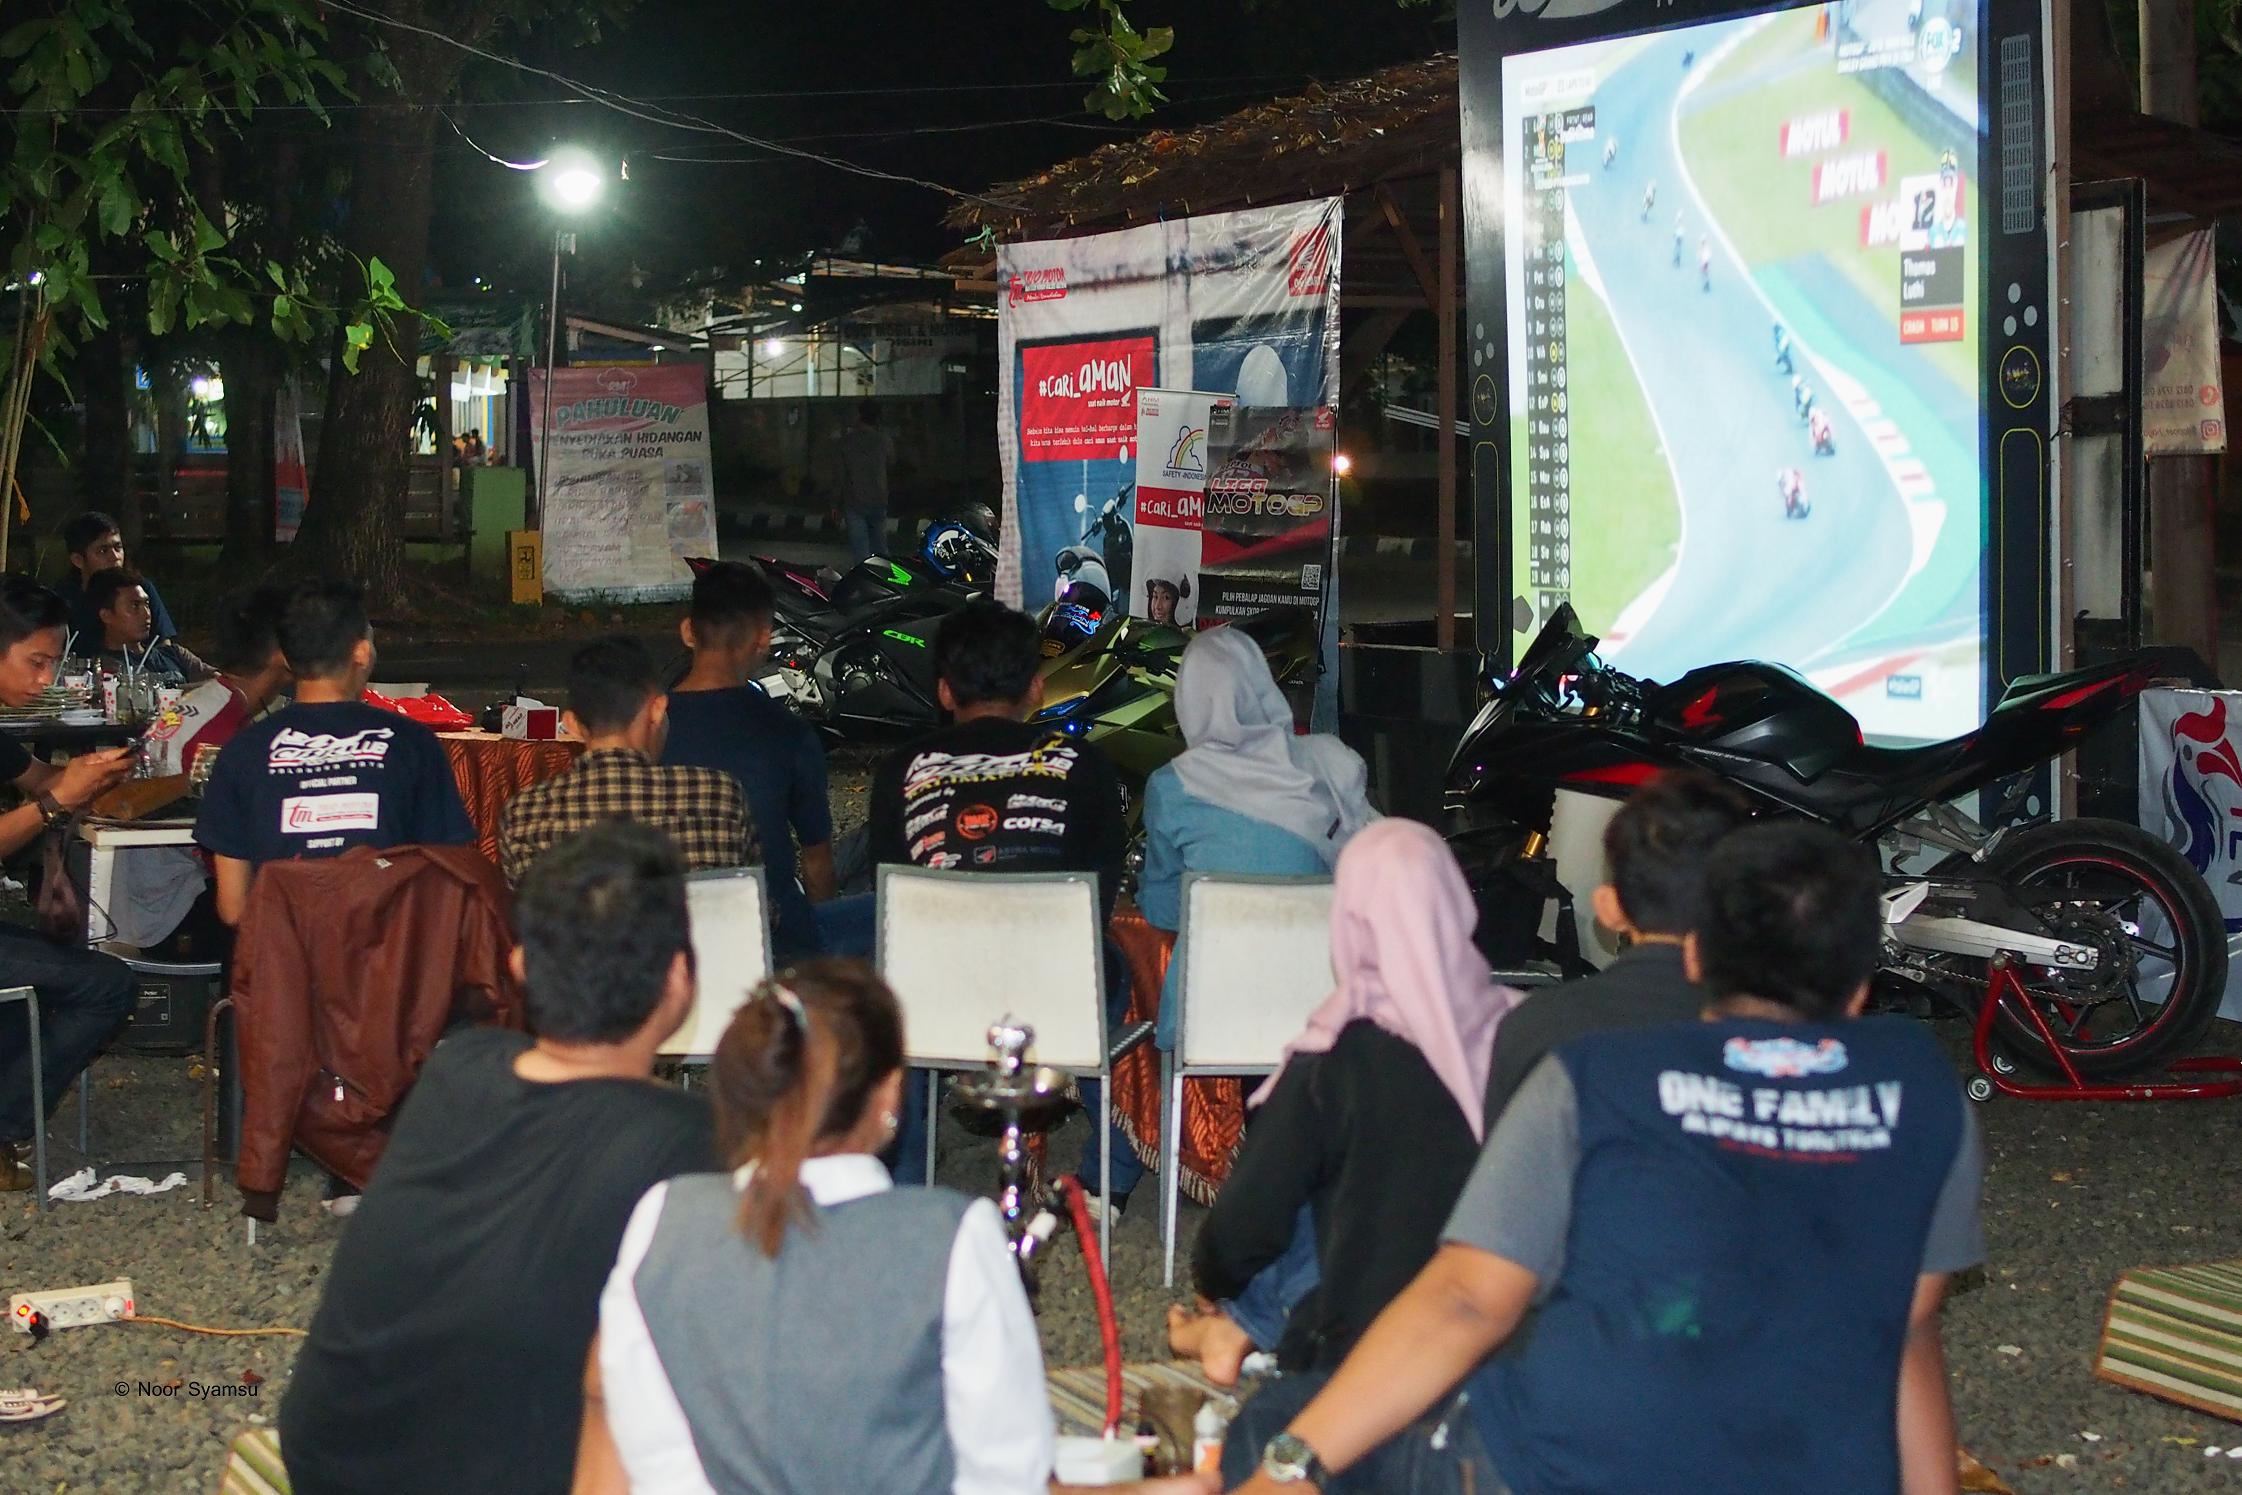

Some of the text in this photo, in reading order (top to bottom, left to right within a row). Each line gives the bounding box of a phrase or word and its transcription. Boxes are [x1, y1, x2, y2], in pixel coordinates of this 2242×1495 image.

[1912, 189, 1936, 231] 12
[556, 397, 683, 431] PAHULUAN
[550, 430, 703, 448] ENYEDIAKAN HIDANGAN
[619, 446, 664, 460] PUASA
[1162, 470, 1181, 478] SAFETY
[1206, 493, 1323, 517] MOTOGP
[1222, 591, 1235, 601] PILIH
[1235, 592, 1258, 603] PEBALAP
[1258, 594, 1277, 604] JAGOAN
[1277, 595, 1292, 605] KAMU
[1299, 596, 1320, 606] MOTOGP
[1215, 605, 1246, 616] KUMPULKAN
[883, 629, 926, 648] CBR
[1657, 1069, 1903, 1129] ONE FAMILY
